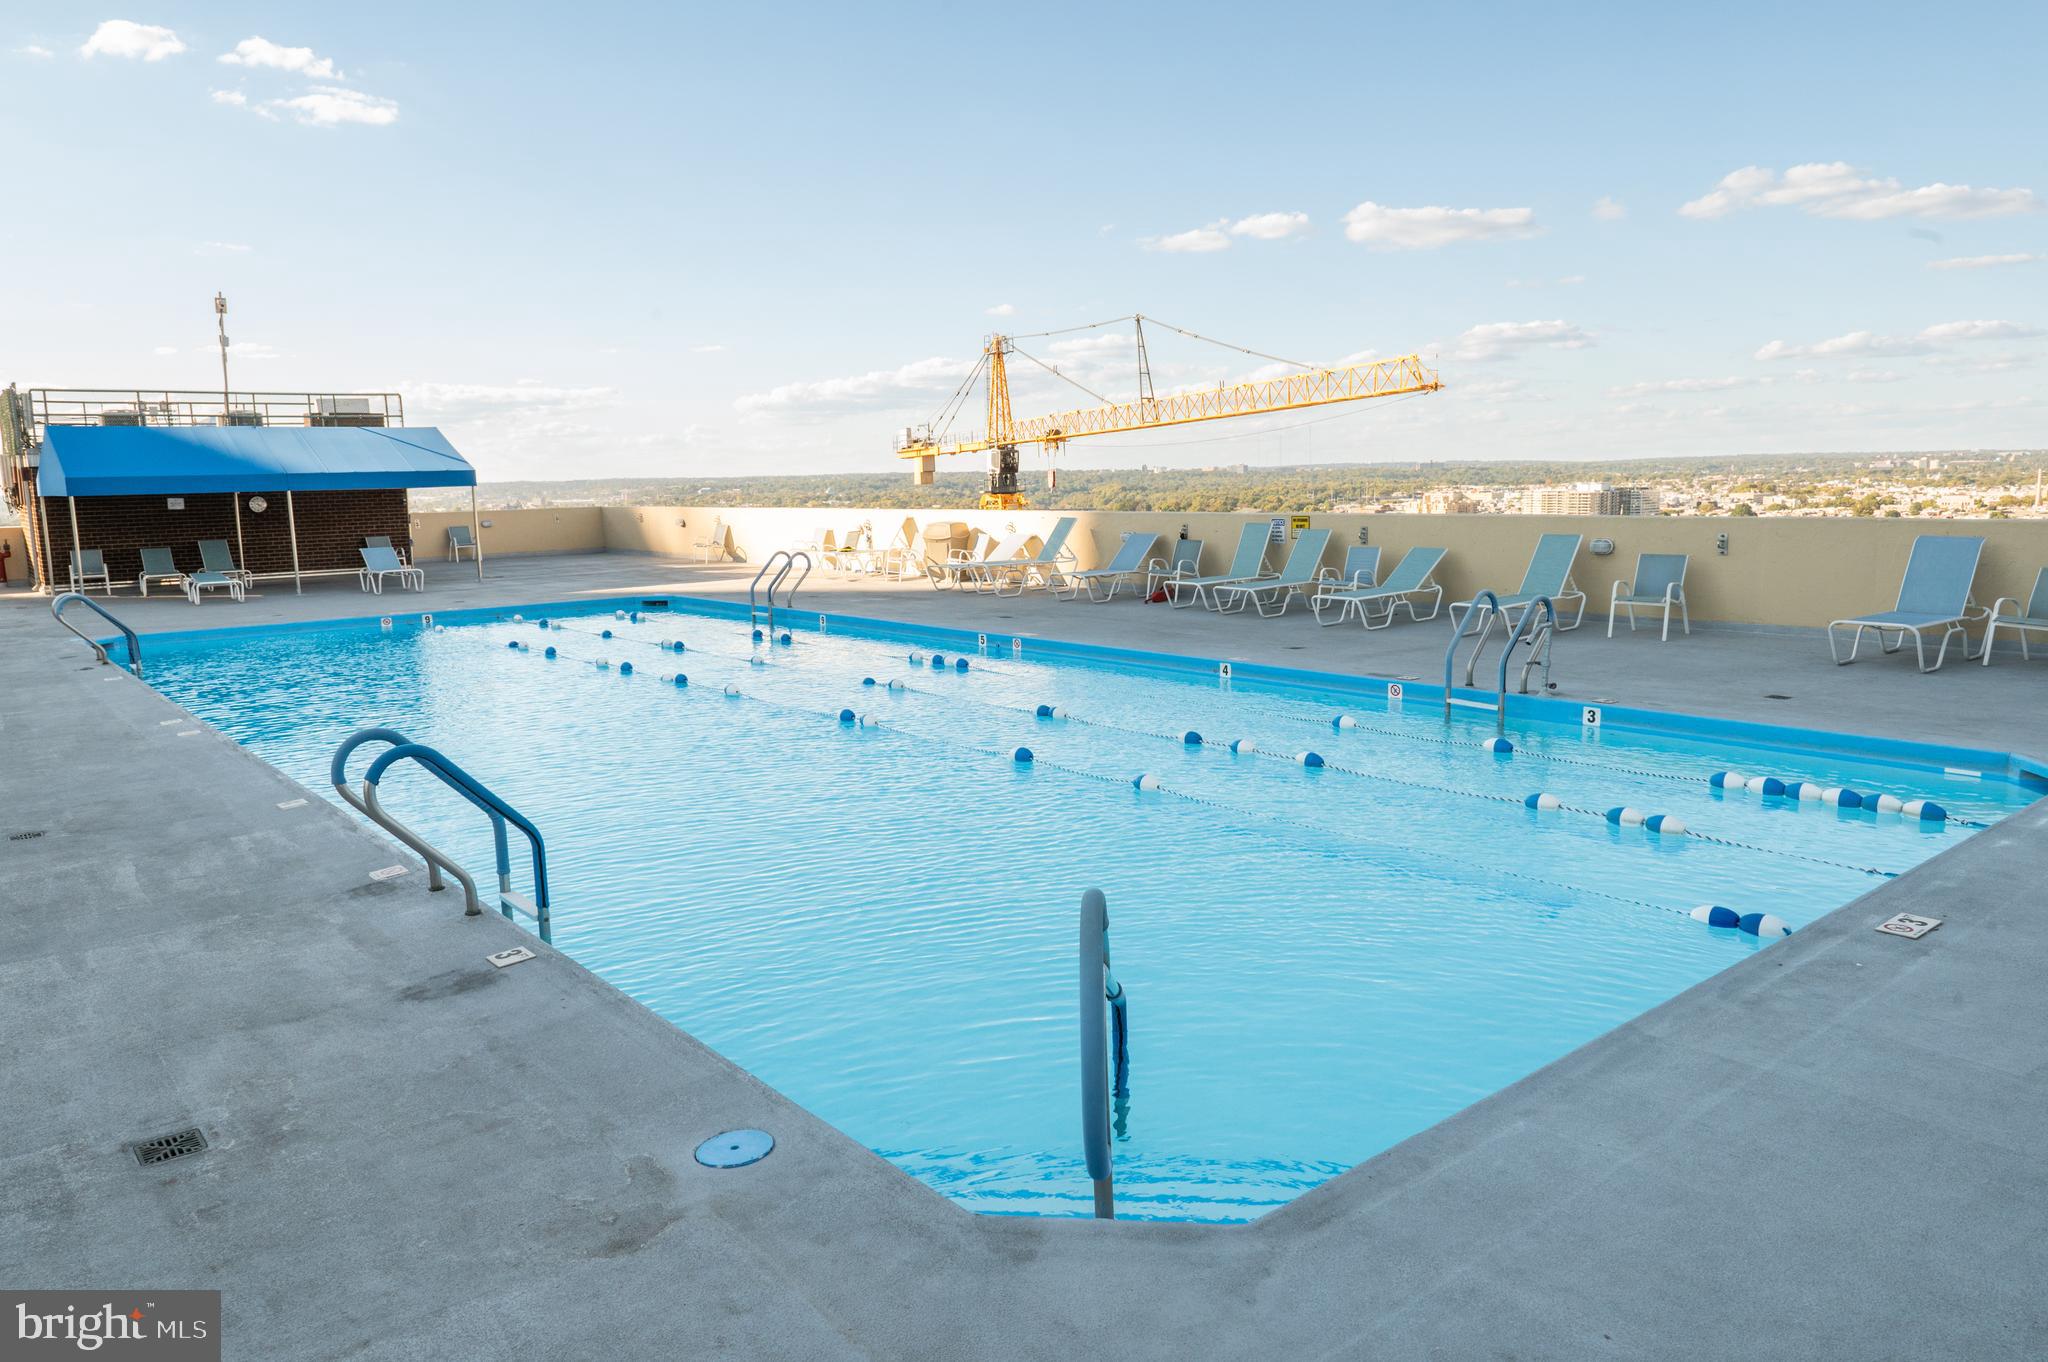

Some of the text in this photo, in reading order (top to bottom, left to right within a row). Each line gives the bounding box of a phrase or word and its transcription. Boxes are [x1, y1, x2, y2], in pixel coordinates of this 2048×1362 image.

[425, 616, 431, 624] 9
[980, 636, 985, 645] 5
[1222, 665, 1229, 676] 4
[1587, 710, 1596, 723] 3
[1898, 918, 1928, 926] 3
[494, 949, 522, 959] 3
